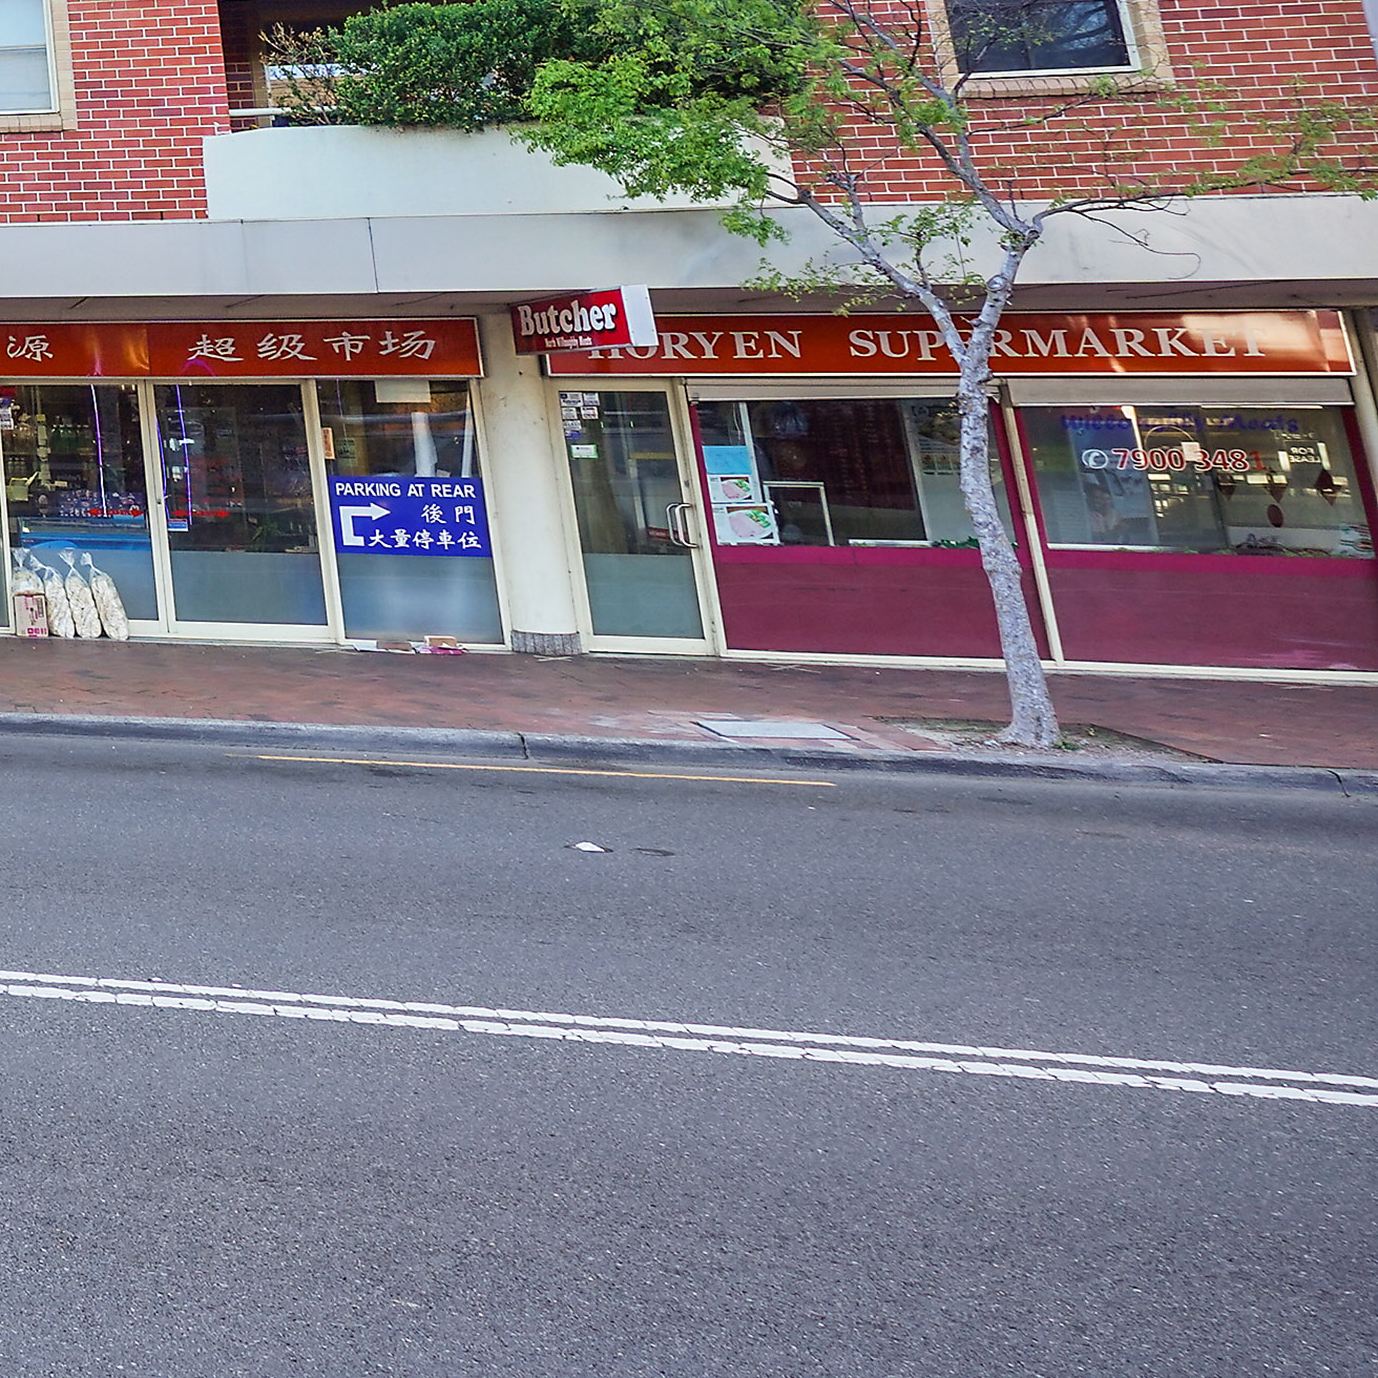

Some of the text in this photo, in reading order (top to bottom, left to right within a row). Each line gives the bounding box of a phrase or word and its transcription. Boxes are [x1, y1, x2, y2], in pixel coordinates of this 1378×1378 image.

[517, 300, 617, 336] Butcher
[185, 330, 438, 362] 超级市场
[849, 327, 1267, 361] SUPRMARKET
[1112, 448, 1267, 471] 7900 3481
[336, 483, 476, 498] PARKING AT REAR
[421, 503, 476, 525] 後門
[368, 529, 482, 550] 大量停車位
